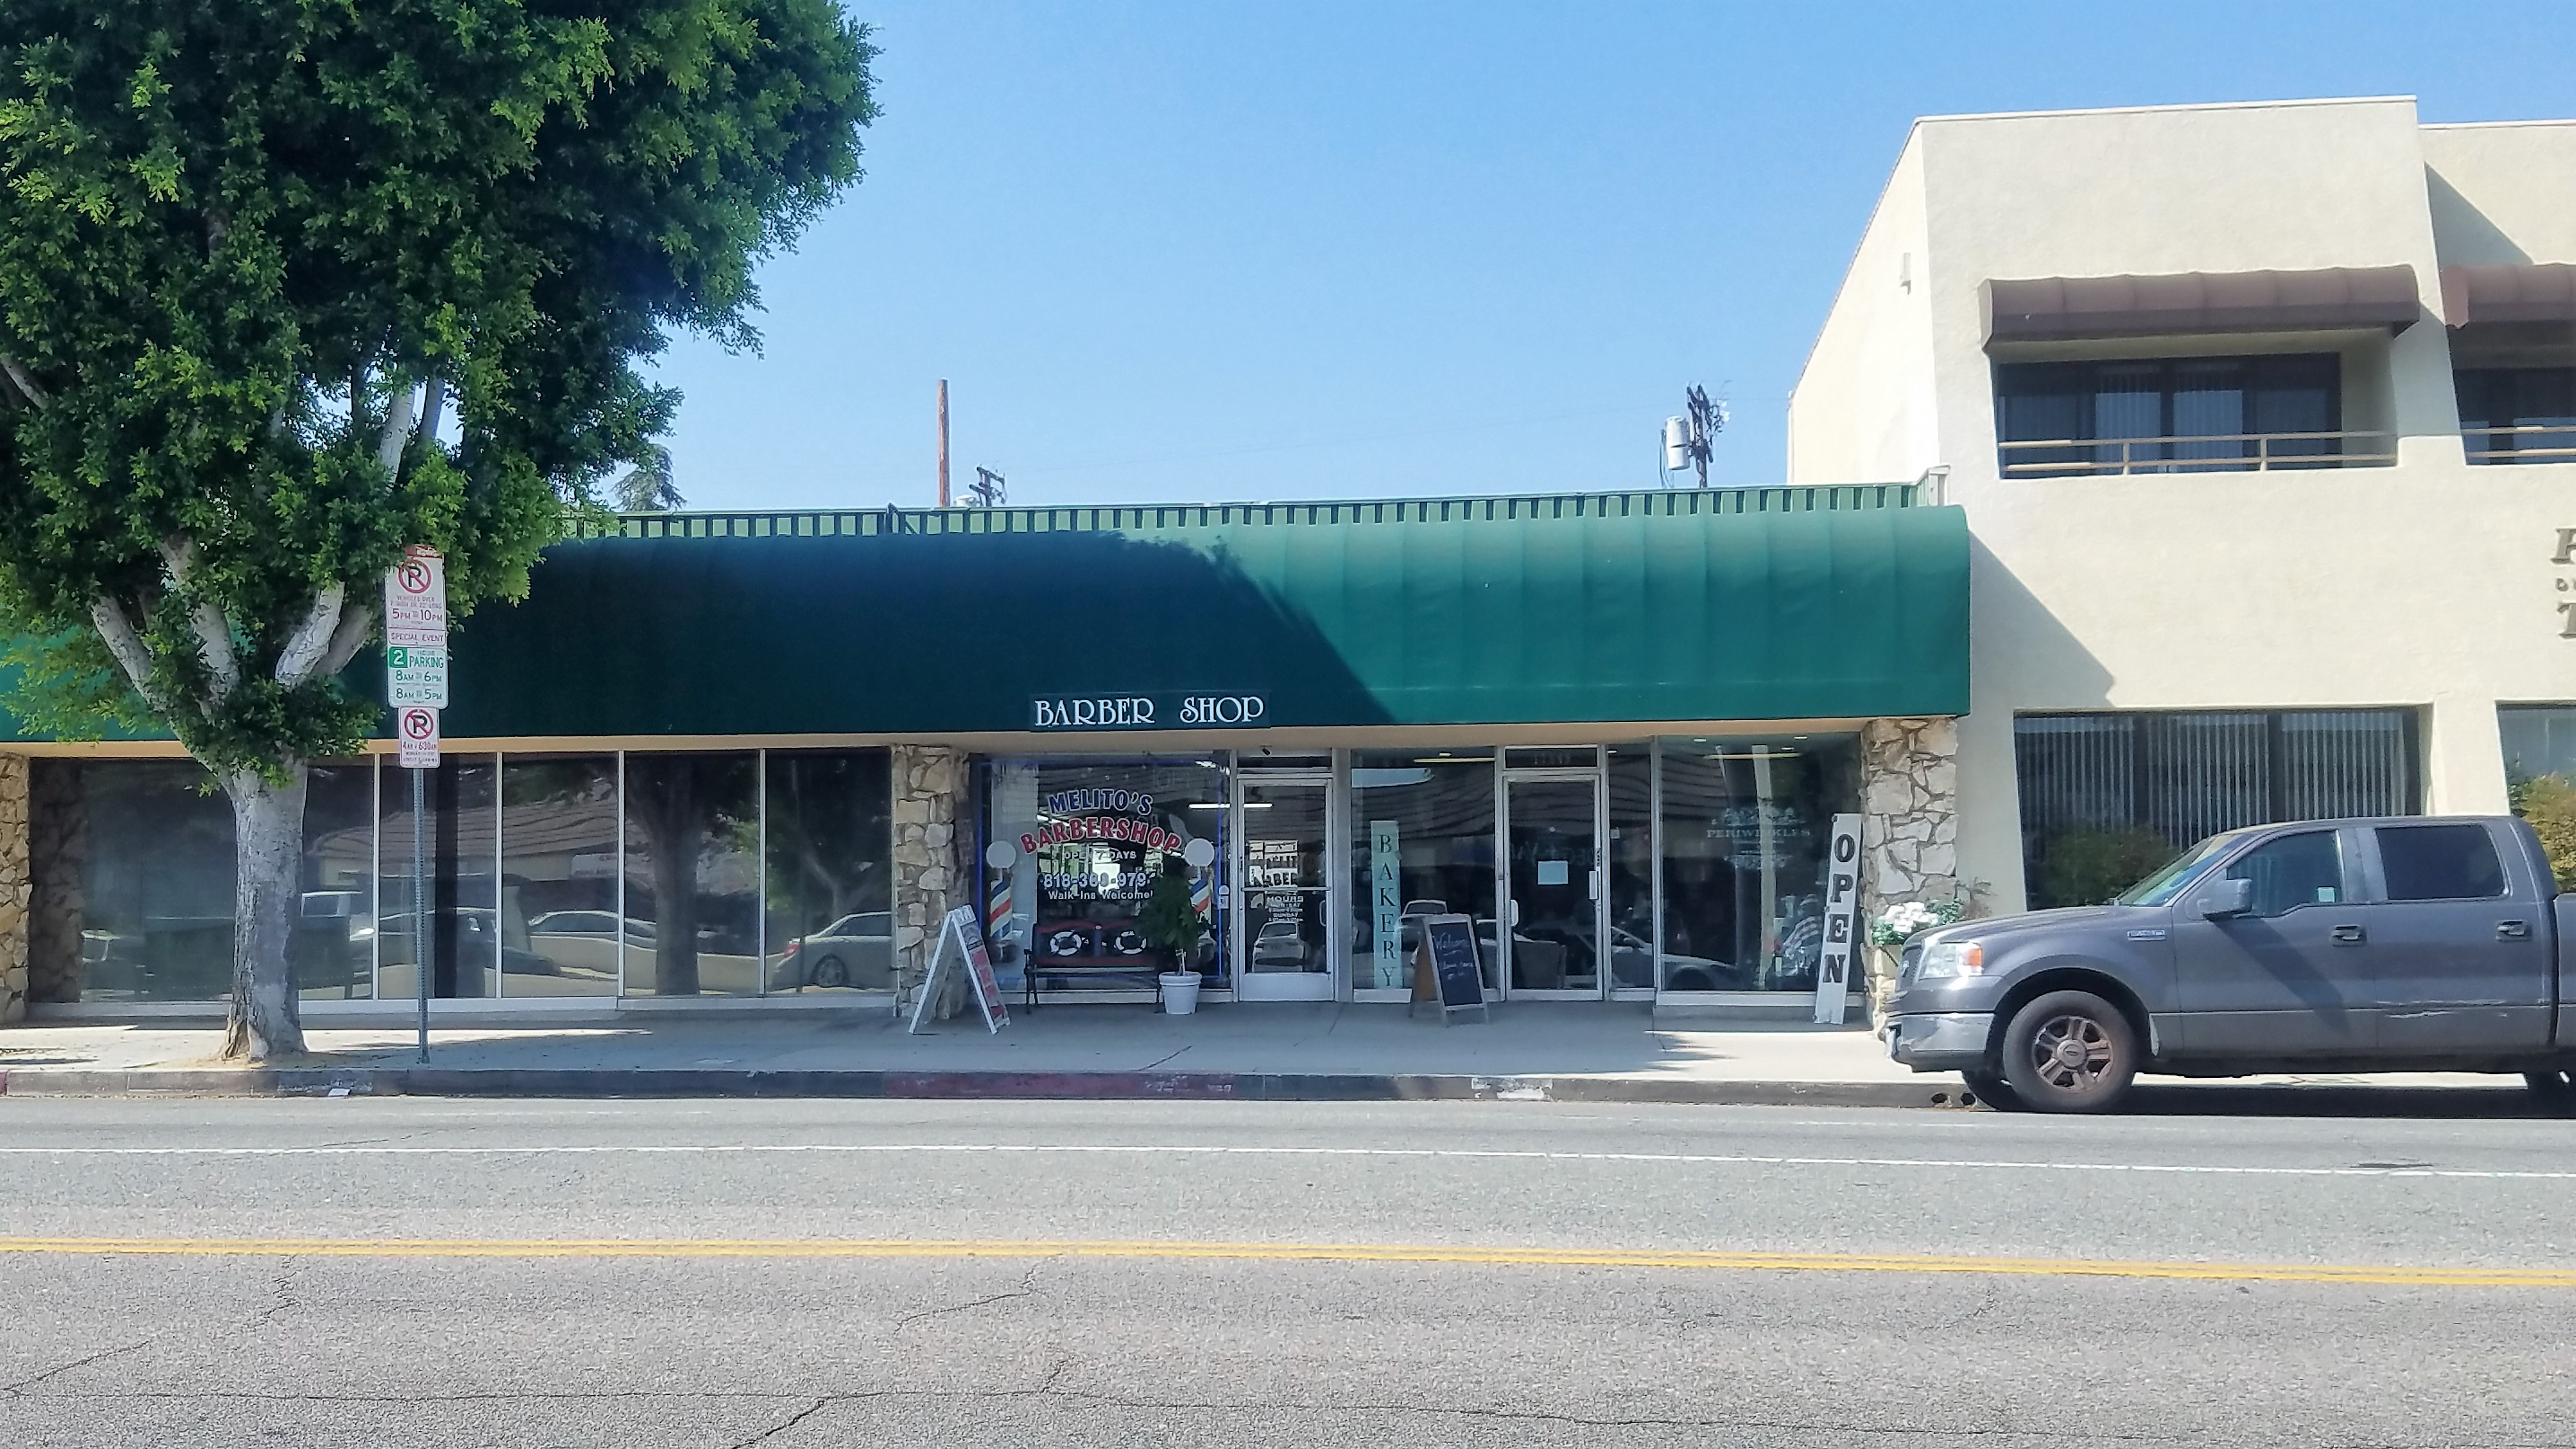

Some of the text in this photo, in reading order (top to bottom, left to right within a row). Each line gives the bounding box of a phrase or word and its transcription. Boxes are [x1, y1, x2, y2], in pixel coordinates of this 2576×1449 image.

[392, 608, 410, 620] 5PM
[421, 610, 443, 622] 10PM
[394, 649, 404, 665] 2
[410, 656, 444, 668] PARKING
[396, 670, 414, 681] 8AM
[424, 671, 442, 682] 6PM
[397, 688, 414, 699] 8AM
[425, 688, 442, 700] 5PM
[1034, 696, 1264, 727] BARBER SHOP
[1048, 788, 1153, 816] MELITO'S
[1020, 816, 1182, 854] BARBERSHOP
[1706, 829, 1811, 838] PERIWIKLES
[1066, 850, 1137, 861] OPE 7 DAYS
[1044, 872, 1156, 888] 818-360-979
[1048, 890, 1154, 900] Walk-Ins Welcome!
[1379, 834, 1397, 987] BAKERY
[1822, 834, 1855, 983] OPEN
